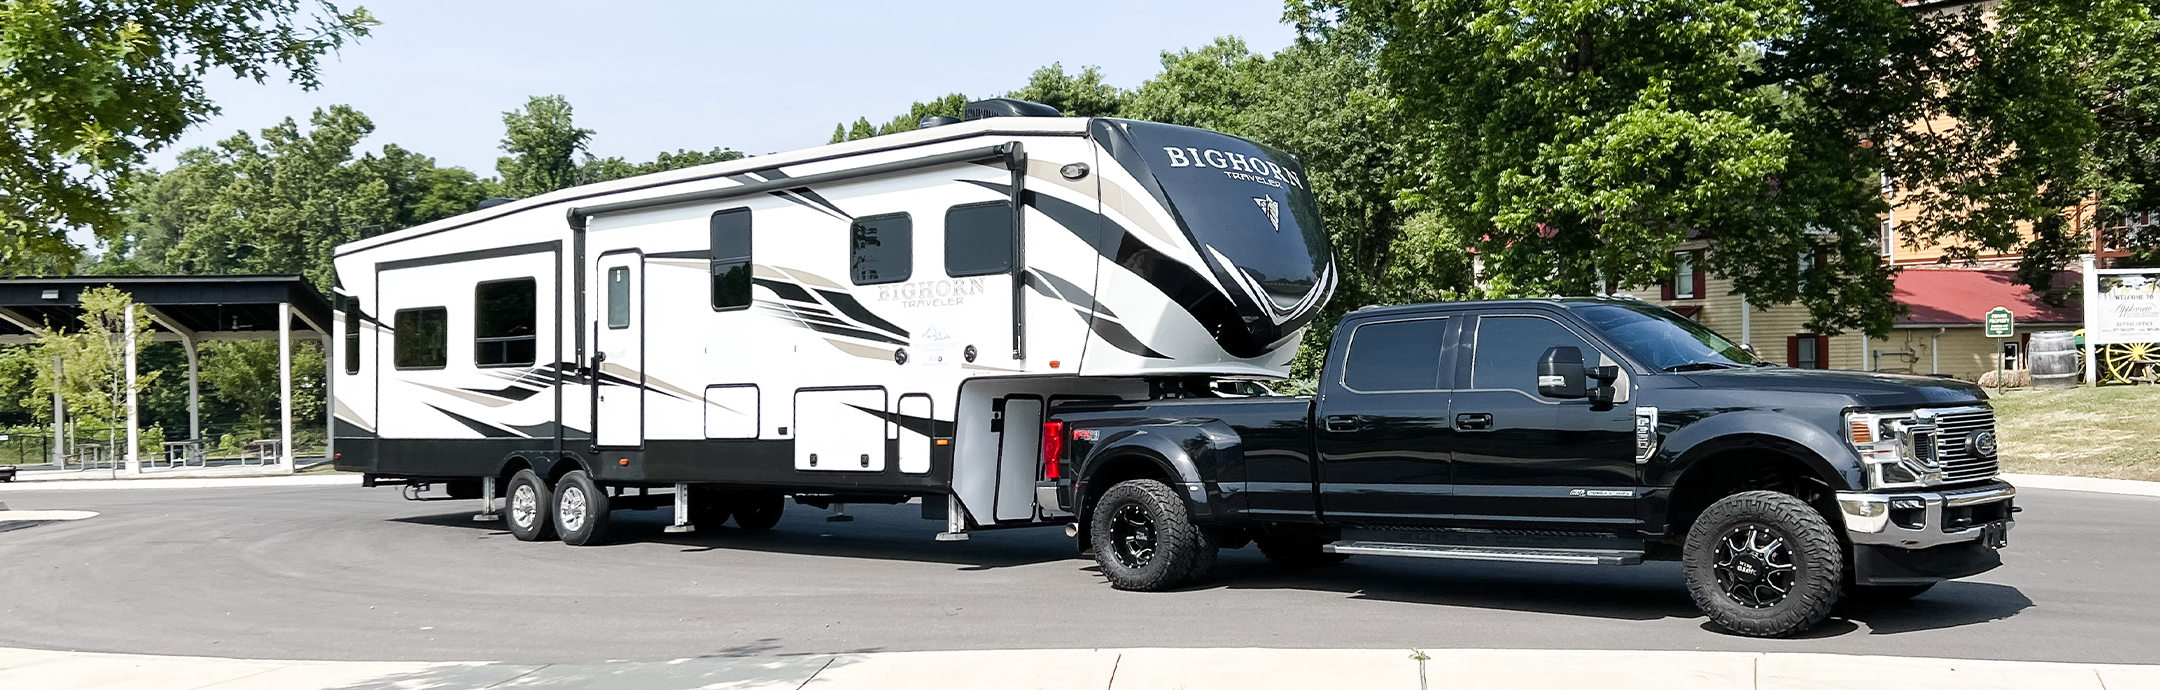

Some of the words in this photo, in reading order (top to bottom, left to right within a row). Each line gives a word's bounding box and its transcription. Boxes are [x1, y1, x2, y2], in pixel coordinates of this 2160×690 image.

[1162, 146, 1304, 190] BIGHORN
[1223, 170, 1284, 189] TRAVELER
[877, 277, 986, 302] BIGHORN
[902, 297, 964, 309] TRAVELER
